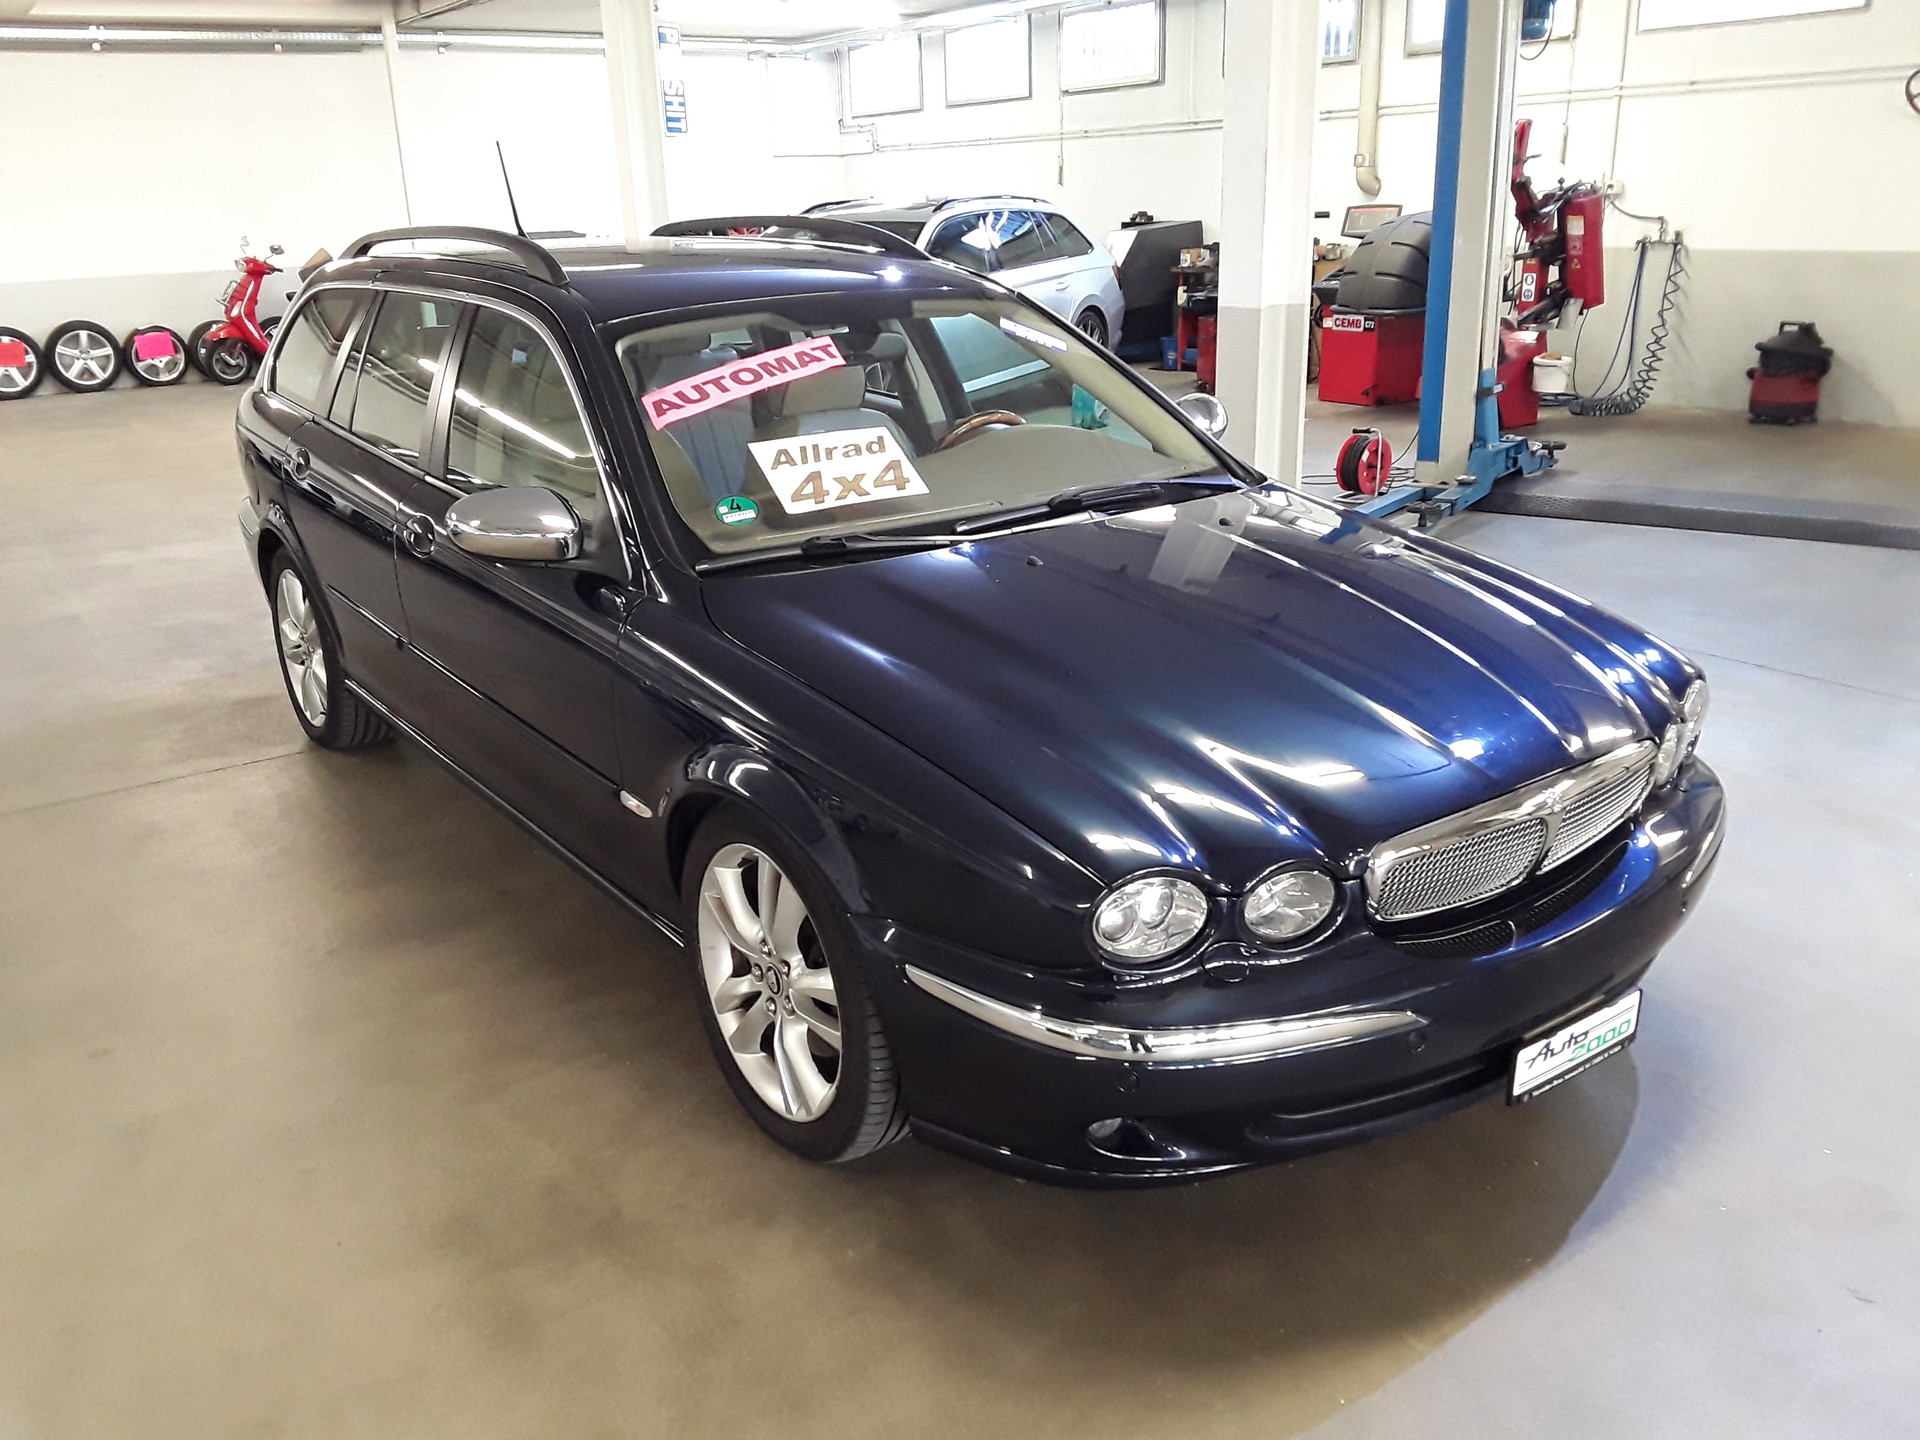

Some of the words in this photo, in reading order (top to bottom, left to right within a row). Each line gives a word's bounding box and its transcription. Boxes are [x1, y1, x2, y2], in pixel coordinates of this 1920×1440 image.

[1334, 317, 1362, 329] CEMB
[651, 343, 839, 418] AUTOMAT
[771, 435, 887, 470] Allrad
[790, 459, 910, 505] 4x4
[730, 498, 742, 510] 4
[1525, 1031, 1590, 1069] Auto
[1567, 1018, 1632, 1063] 2000
